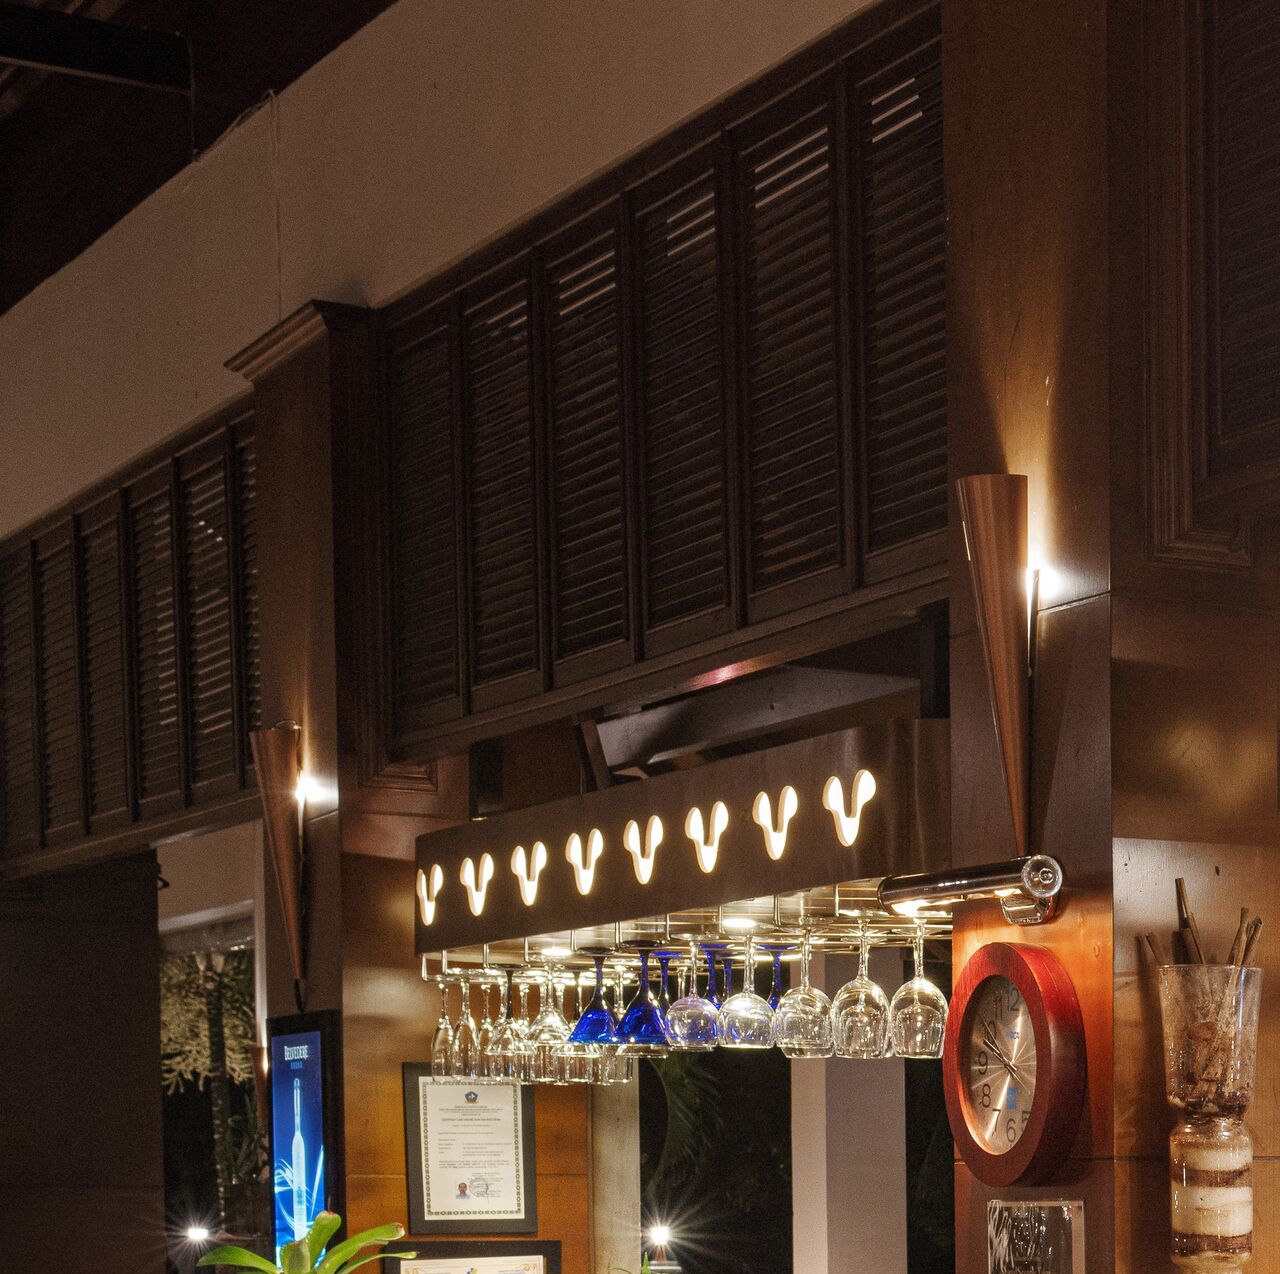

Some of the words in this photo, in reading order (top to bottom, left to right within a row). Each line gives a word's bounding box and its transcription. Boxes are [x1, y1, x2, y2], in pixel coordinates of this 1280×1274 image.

[978, 1051, 988, 1076] 9
[981, 1083, 992, 1109] 8
[1006, 1117, 1017, 1144] 6
